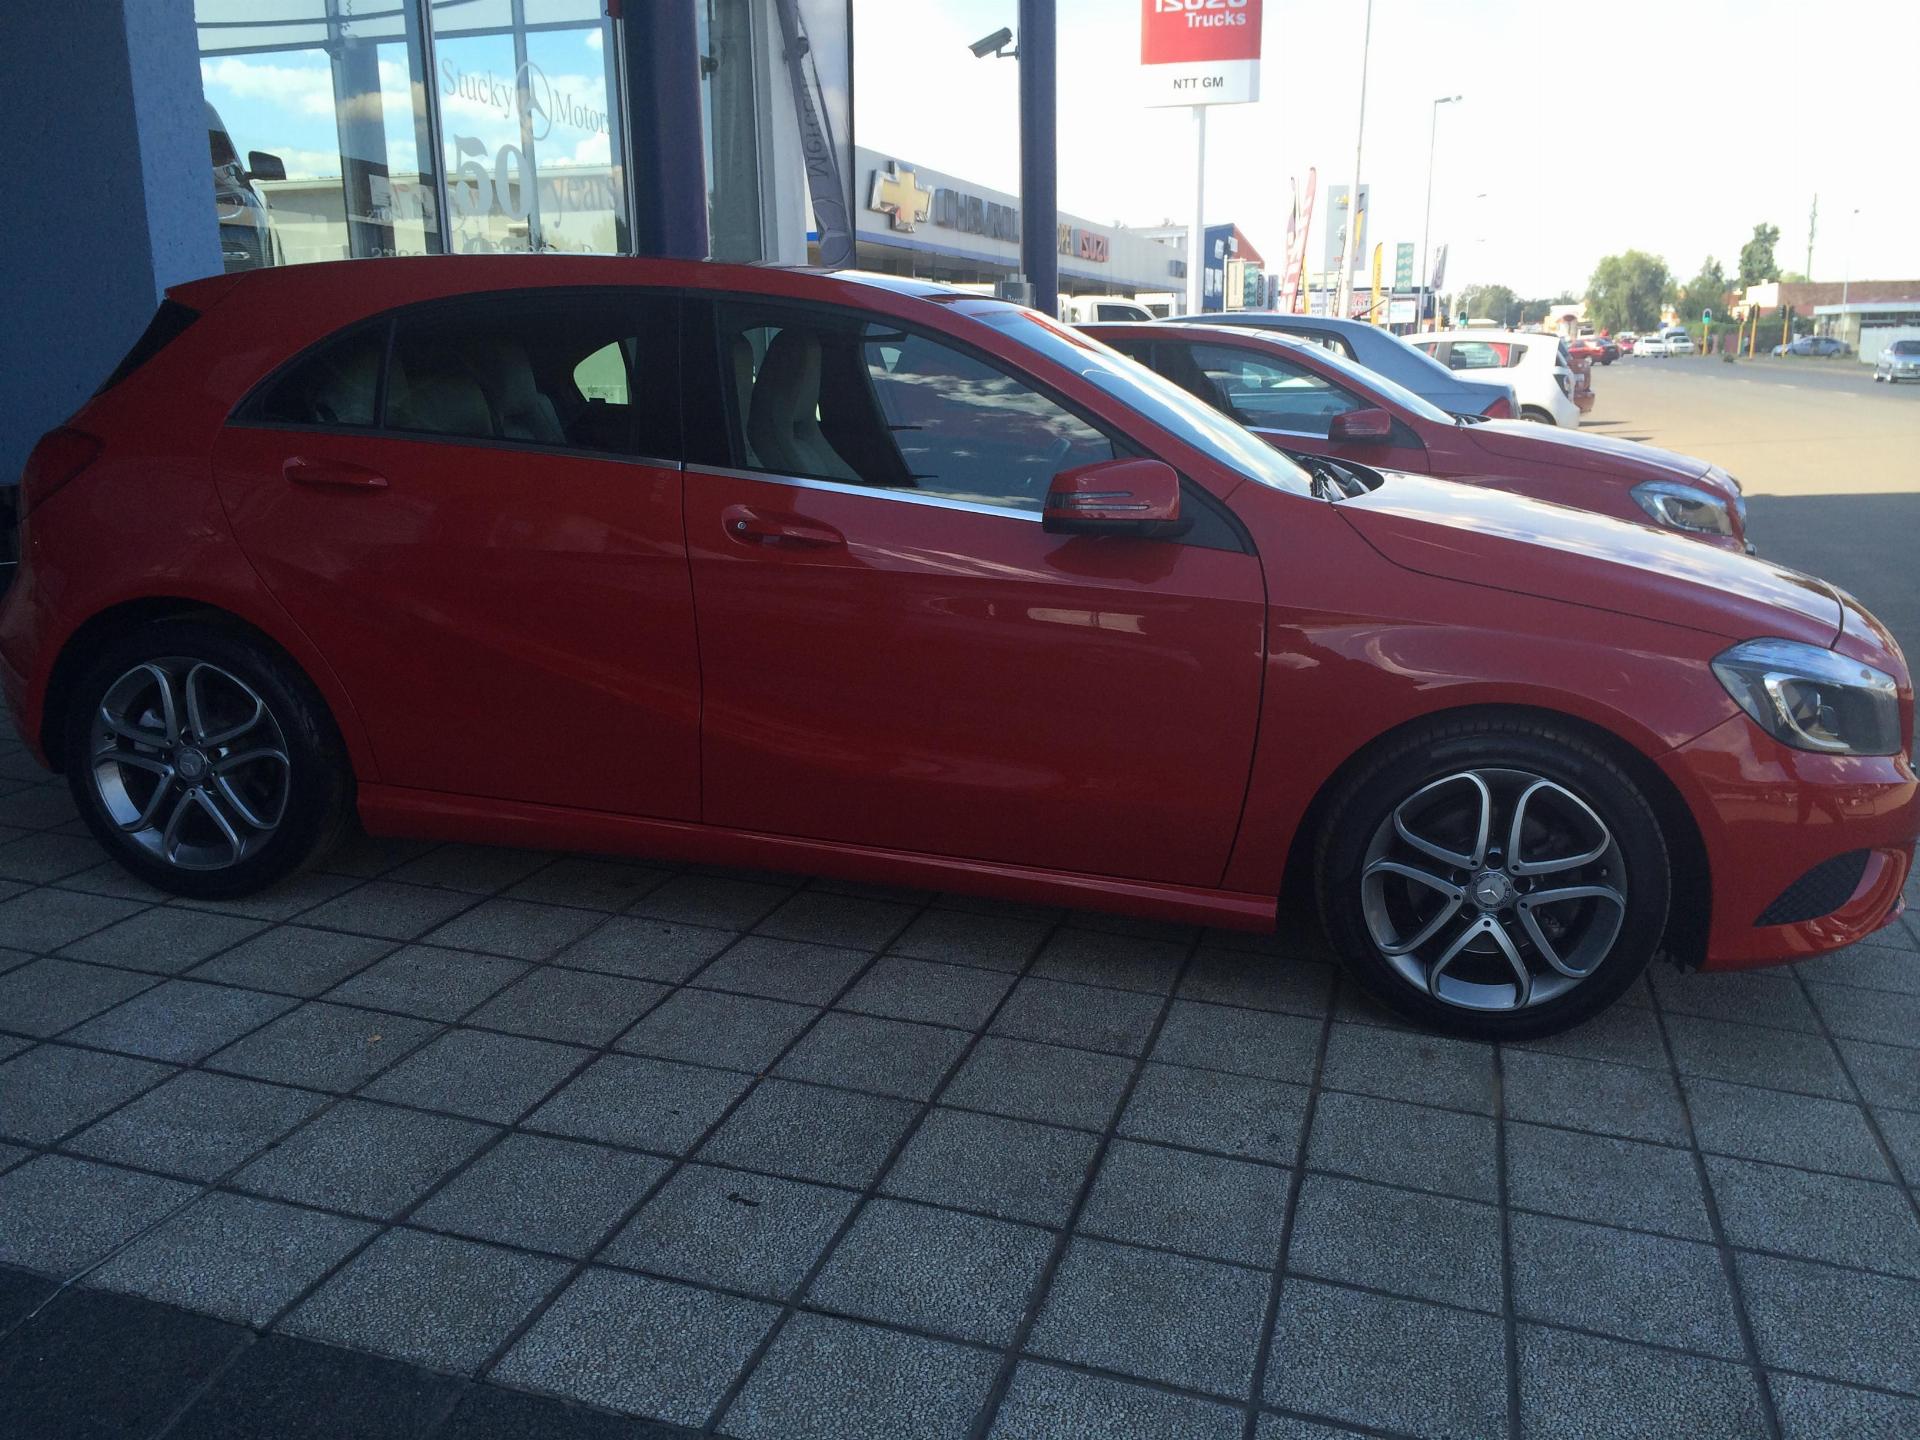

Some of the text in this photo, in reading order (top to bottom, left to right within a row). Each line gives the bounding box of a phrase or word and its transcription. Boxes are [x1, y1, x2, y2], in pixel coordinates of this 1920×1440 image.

[1185, 11, 1246, 28] Trucks
[441, 58, 613, 136] Stucky Motors
[1173, 76, 1224, 89] NTT GM
[453, 134, 618, 229] 50 years
[1076, 228, 1111, 263] ISUZU
